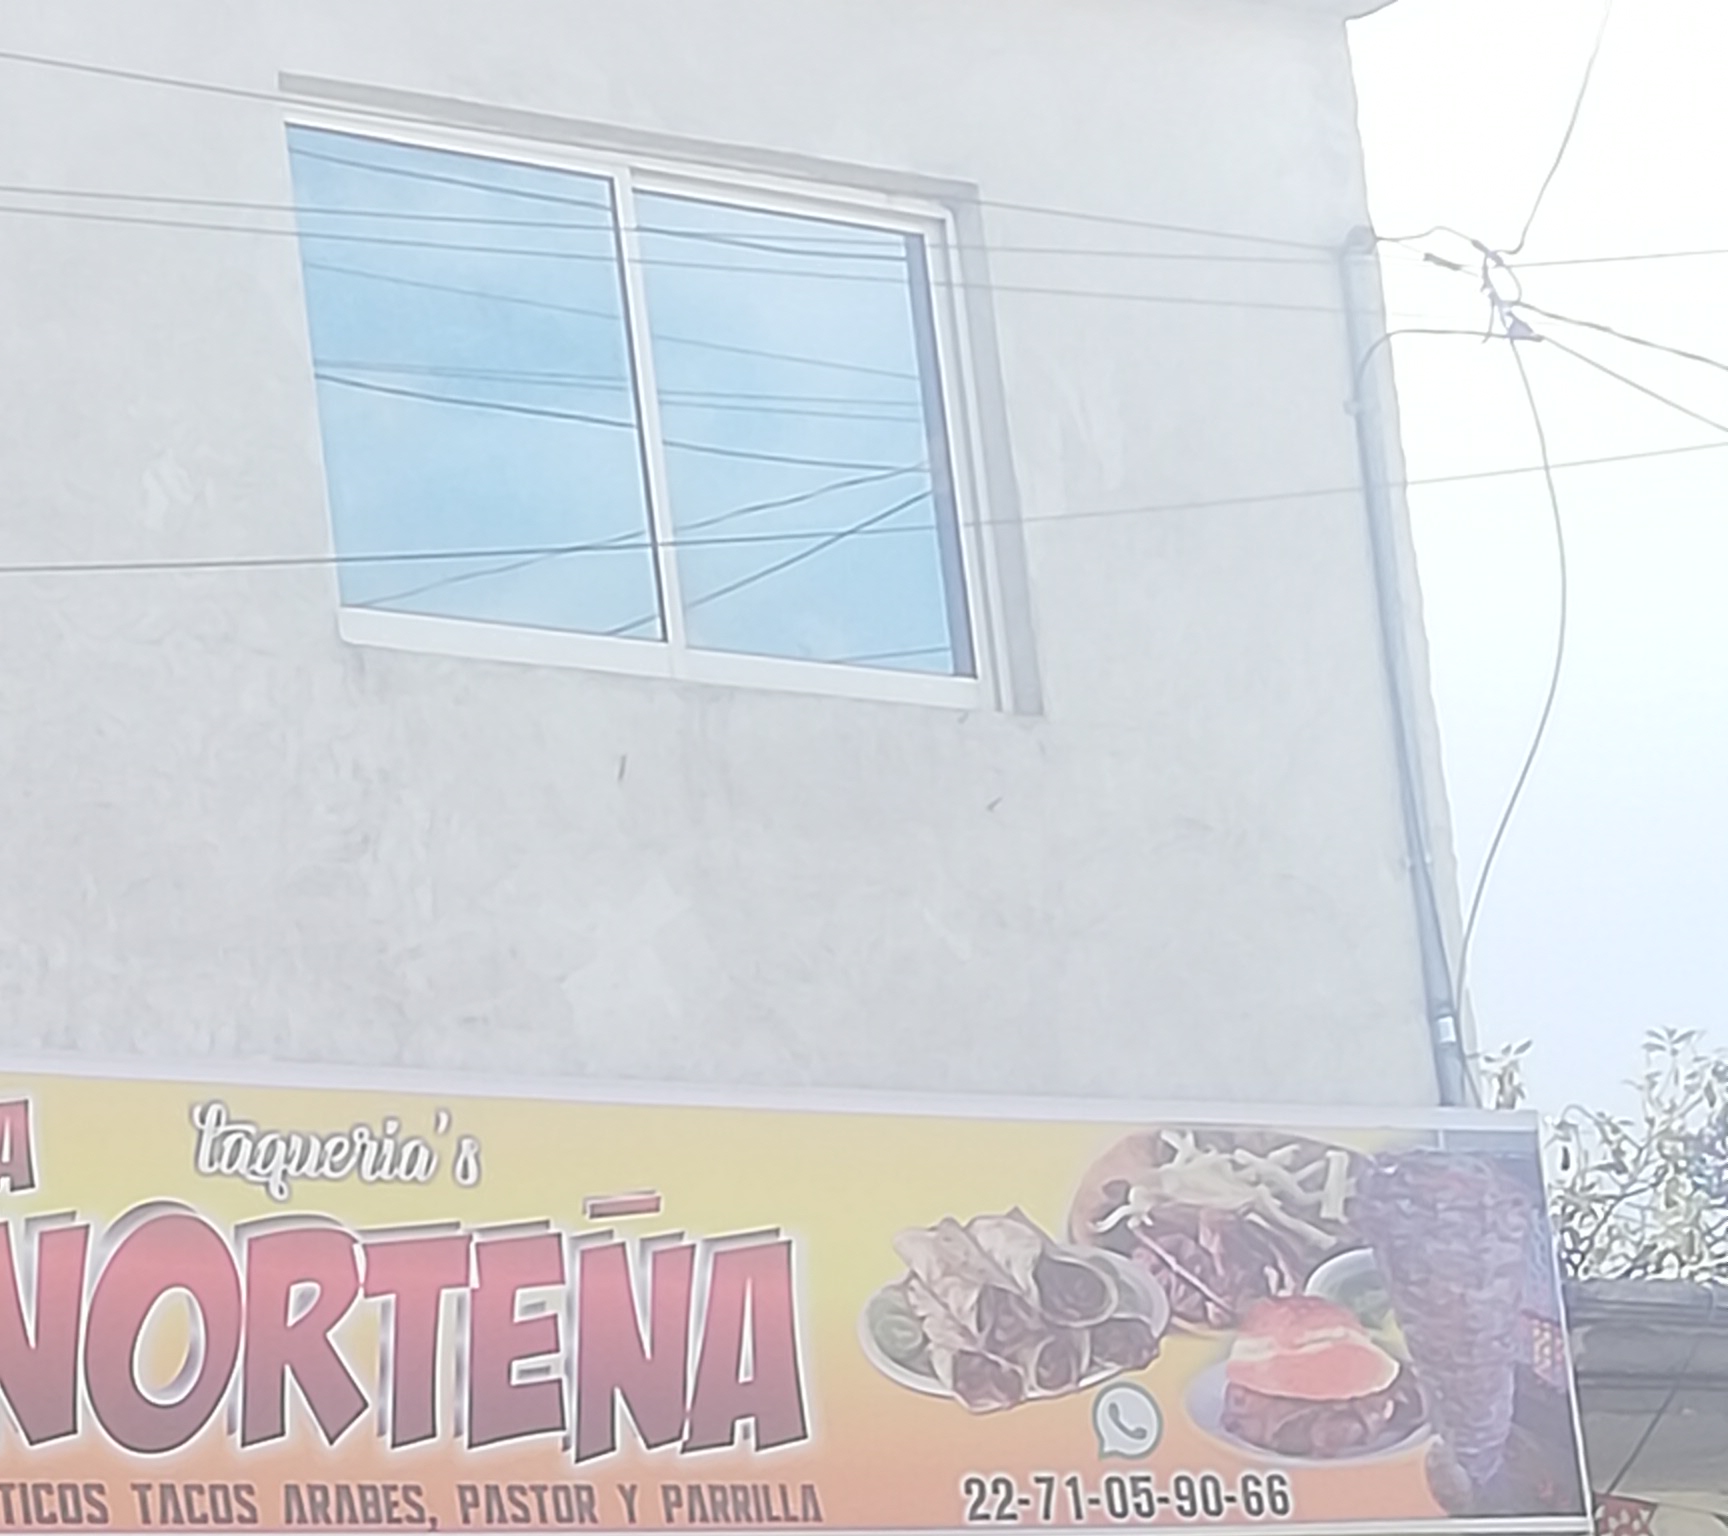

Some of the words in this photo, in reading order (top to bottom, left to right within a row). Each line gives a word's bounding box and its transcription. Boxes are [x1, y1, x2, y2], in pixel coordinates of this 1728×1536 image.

[131, 1481, 259, 1525] TACOS
[284, 1482, 440, 1532] ARABES,
[458, 1482, 599, 1525] PASTOR
[616, 1483, 639, 1523] Y
[662, 1483, 823, 1523] PARRILLA
[964, 1474, 1291, 1521] 22-71-05-90-66
